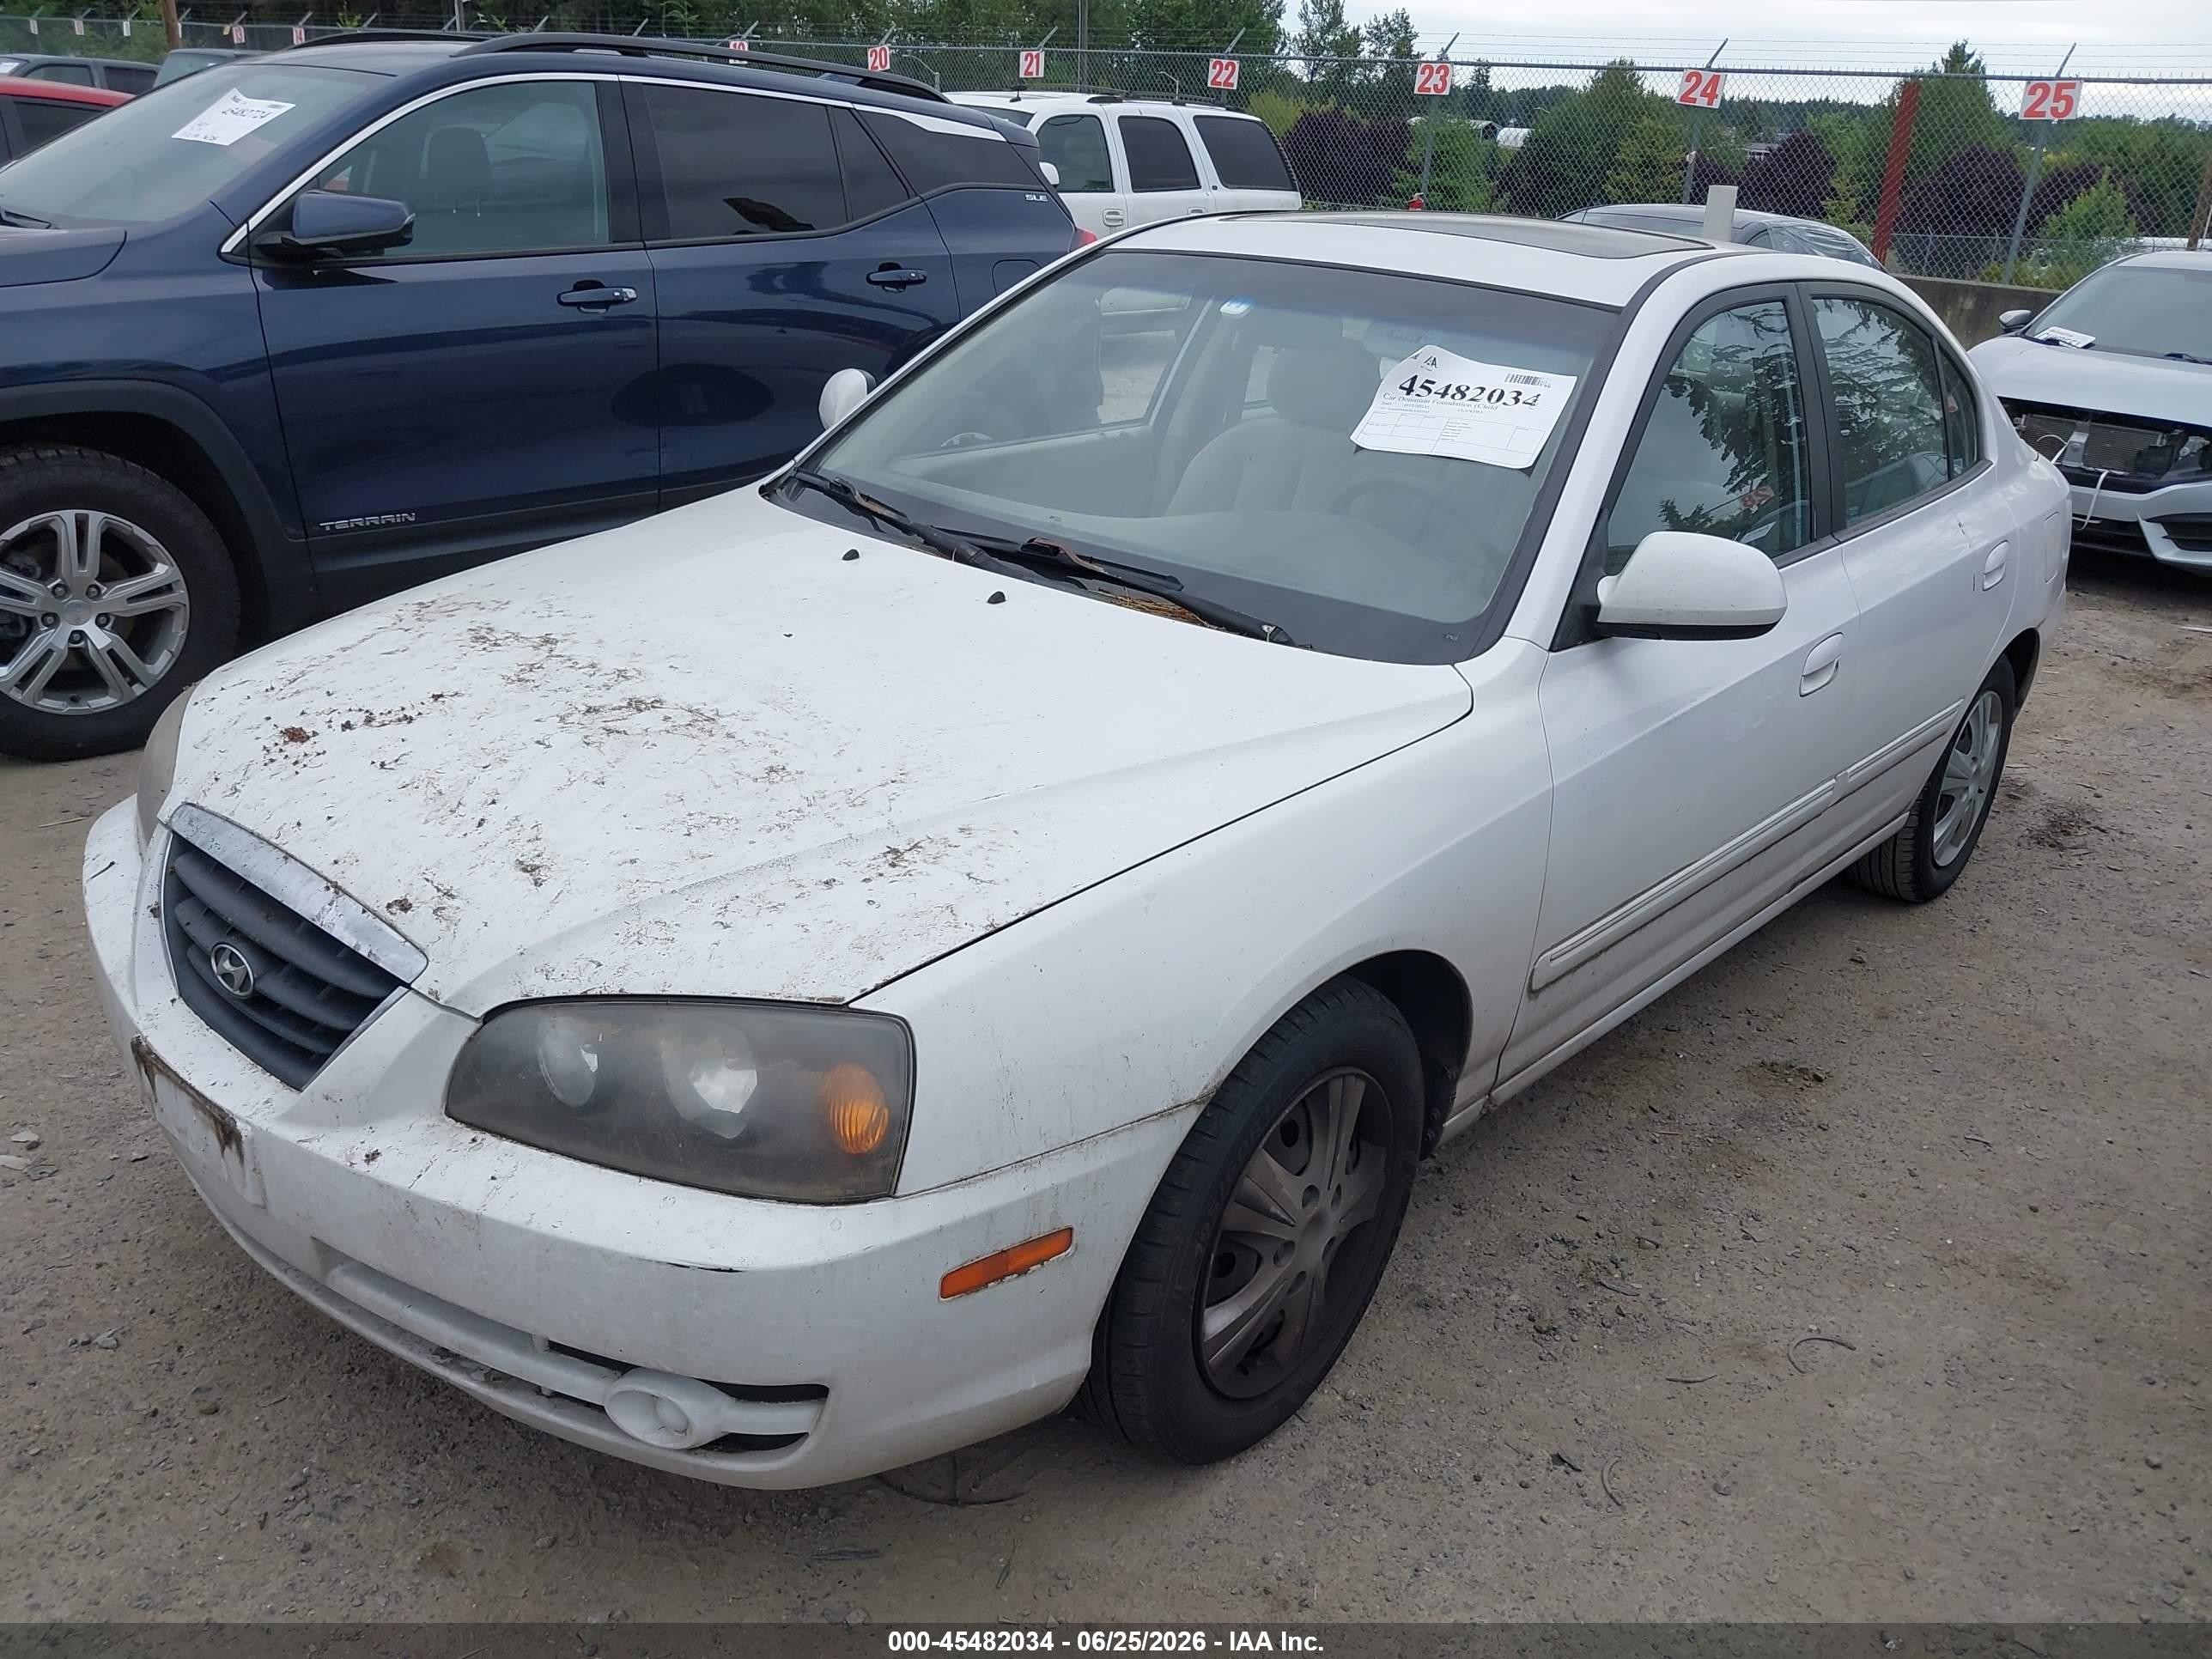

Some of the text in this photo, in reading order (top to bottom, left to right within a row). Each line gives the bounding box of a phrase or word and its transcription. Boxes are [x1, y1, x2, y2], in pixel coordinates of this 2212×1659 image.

[869, 47, 889, 70] 20
[1024, 52, 1040, 76] 21
[1210, 60, 1237, 88] 22
[1417, 64, 1449, 94] 23
[1680, 71, 1721, 106] 24
[2023, 82, 2076, 118] 25
[1382, 392, 1396, 401] Car
[1431, 399, 1472, 408] Foundation
[1398, 374, 1541, 407] 45482034
[319, 513, 416, 531] TERRAIN
